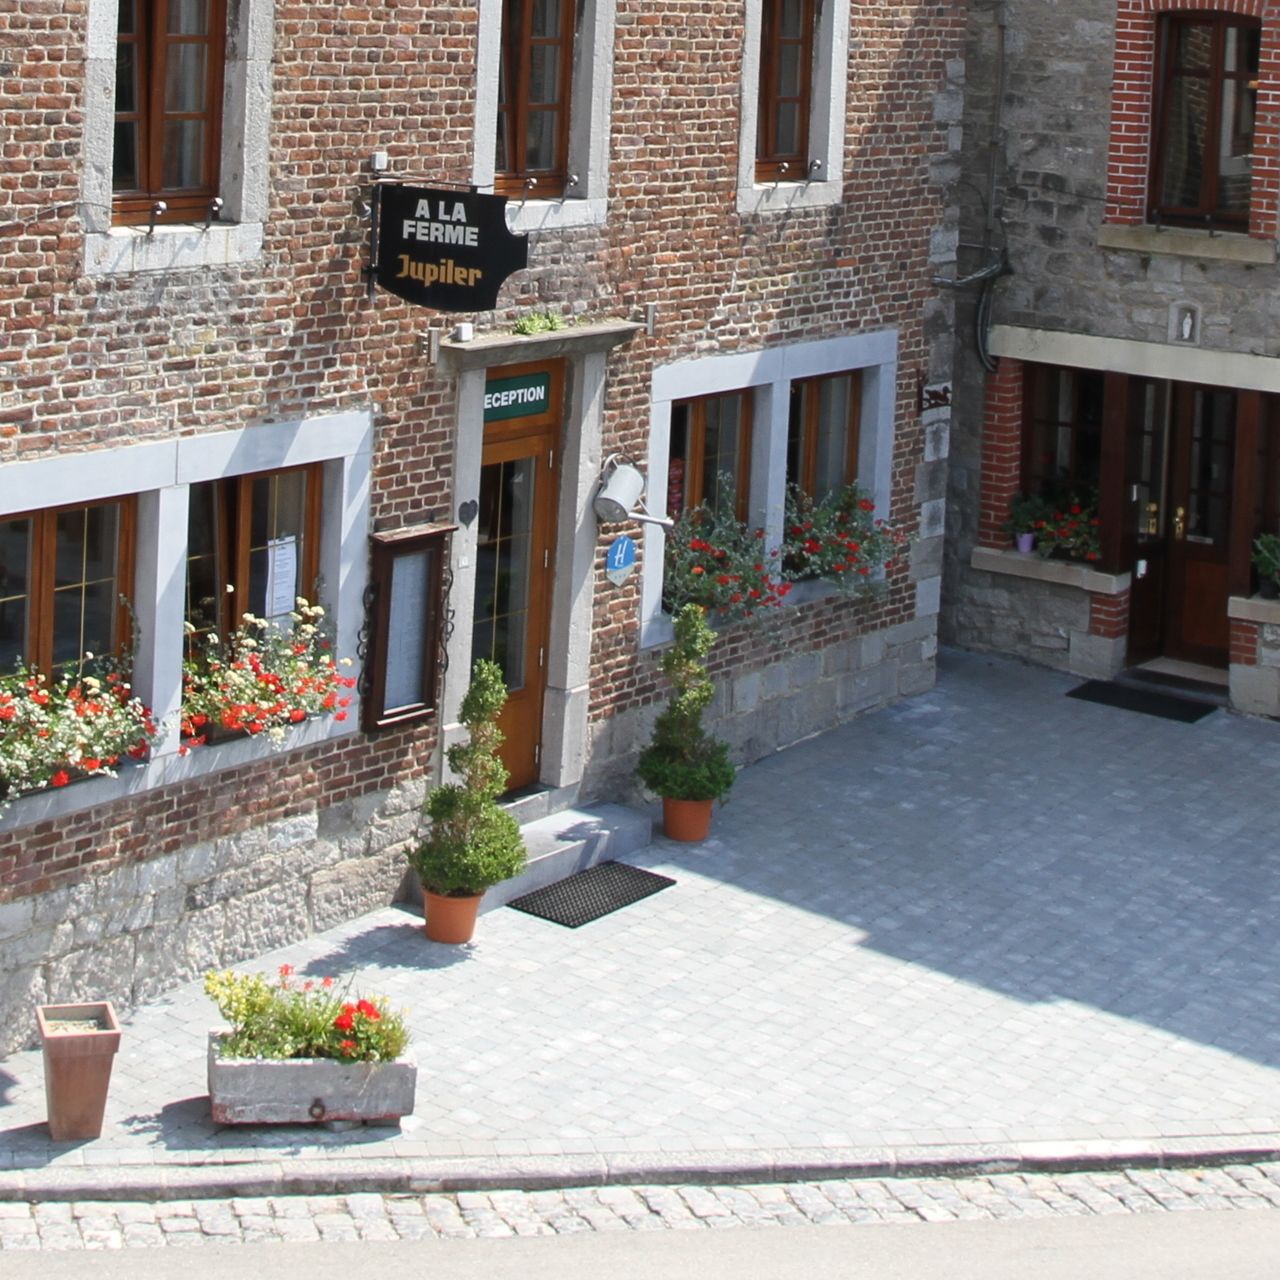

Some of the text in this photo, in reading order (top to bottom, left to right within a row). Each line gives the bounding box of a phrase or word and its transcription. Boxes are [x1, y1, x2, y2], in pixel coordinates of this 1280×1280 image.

[415, 199, 467, 222] A LA
[402, 219, 479, 247] FERME
[396, 254, 482, 287] Jupiler
[484, 385, 545, 409] ECEPTION
